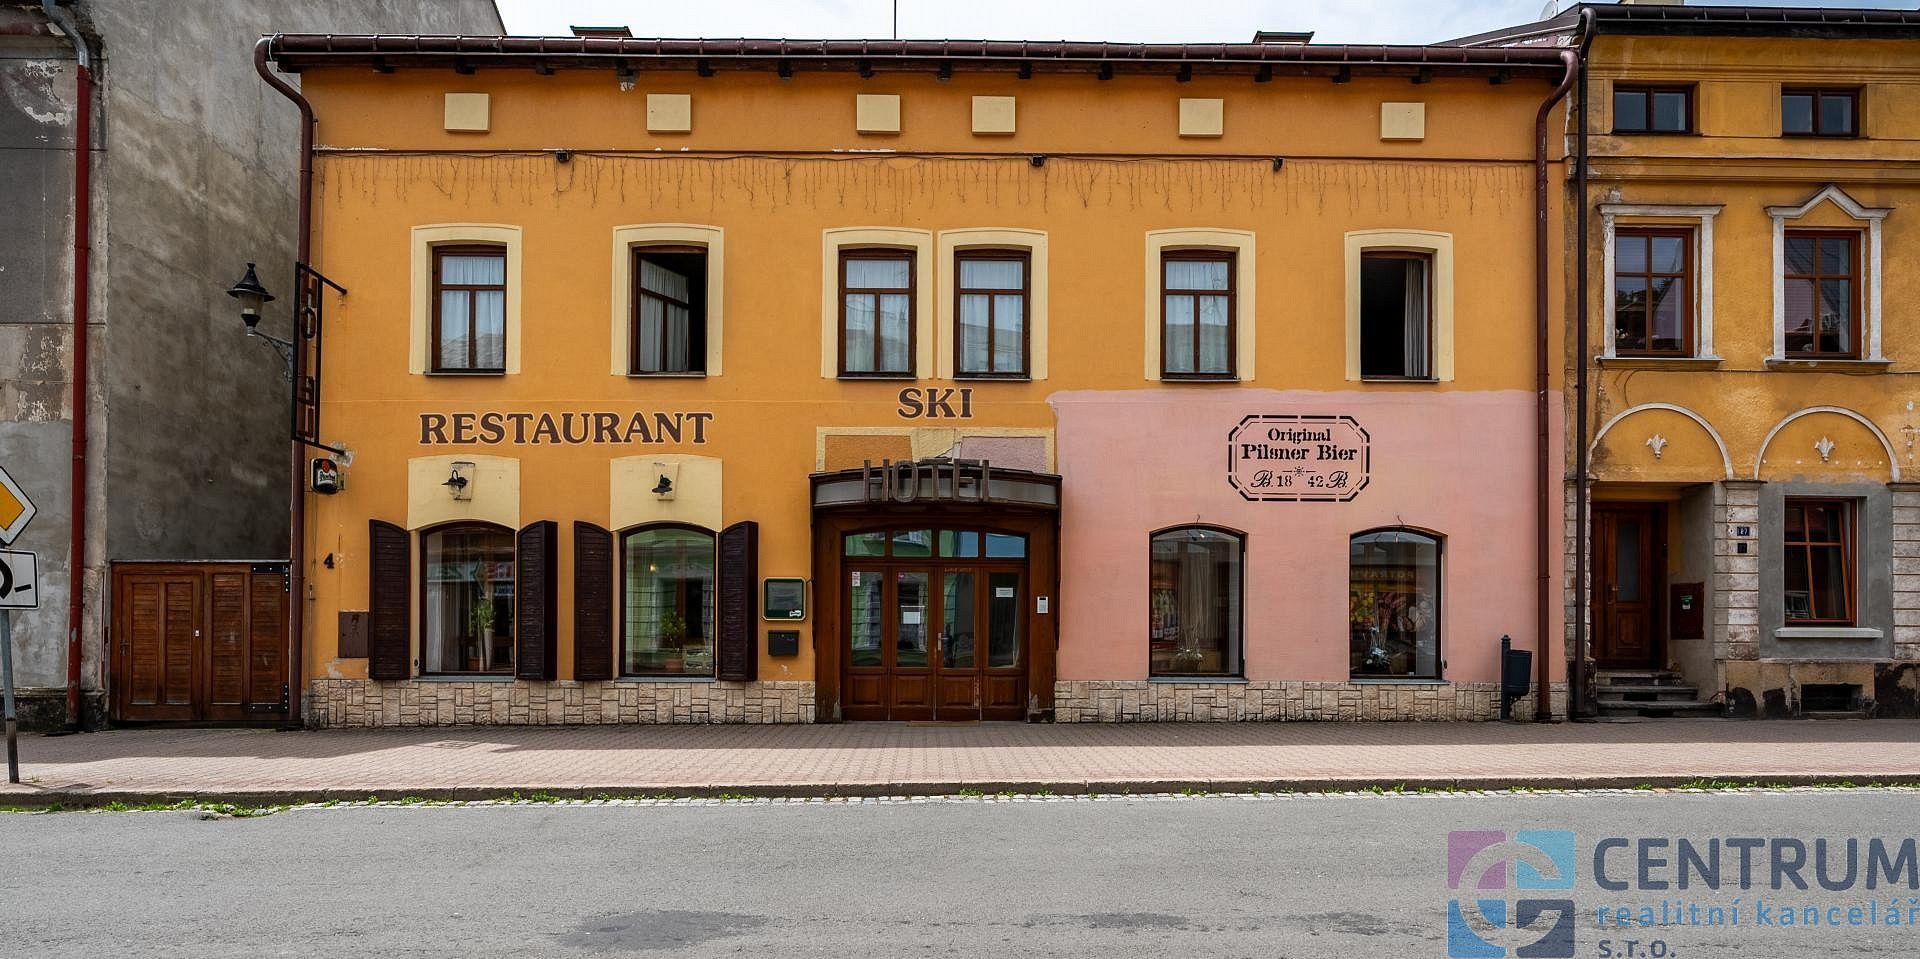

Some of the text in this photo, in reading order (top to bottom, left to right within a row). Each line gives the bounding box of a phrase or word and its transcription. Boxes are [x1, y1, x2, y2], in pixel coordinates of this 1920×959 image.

[897, 388, 973, 418] SKI
[419, 413, 713, 444] RESTAURANT
[1268, 427, 1331, 444] Original
[1241, 443, 1358, 460] Pilsner Bier
[864, 459, 1008, 502] HOTEL
[323, 552, 335, 570] 4
